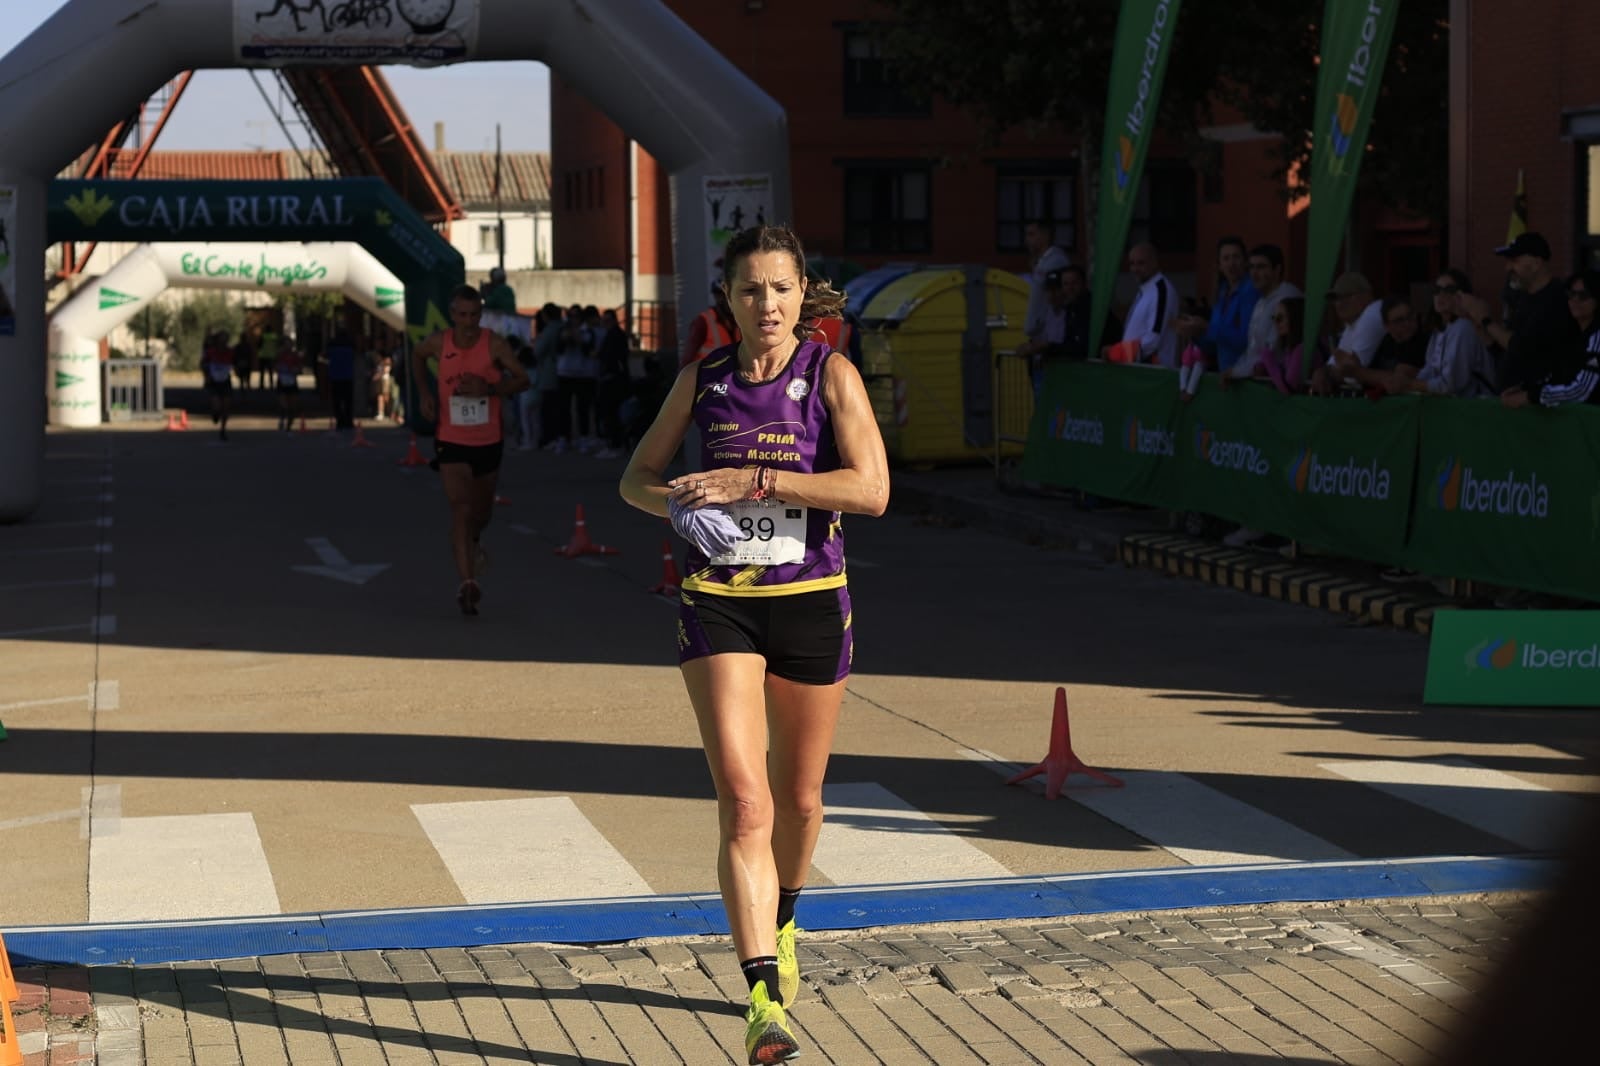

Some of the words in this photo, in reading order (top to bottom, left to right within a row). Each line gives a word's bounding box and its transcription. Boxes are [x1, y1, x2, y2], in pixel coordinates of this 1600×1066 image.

[118, 195, 215, 233] CAJA
[225, 193, 354, 227] RURAL
[182, 252, 201, 275] El
[204, 255, 252, 278] Corte
[256, 252, 328, 287] Inglés
[461, 404, 476, 417] 81
[708, 421, 739, 433] Jamón
[757, 432, 795, 445] PRIM
[747, 448, 801, 462] Macotera
[1308, 452, 1391, 501] Iberdrola
[1460, 466, 1549, 518] Iberdrola
[739, 516, 775, 542] 89
[1521, 642, 1600, 669] Iberd
